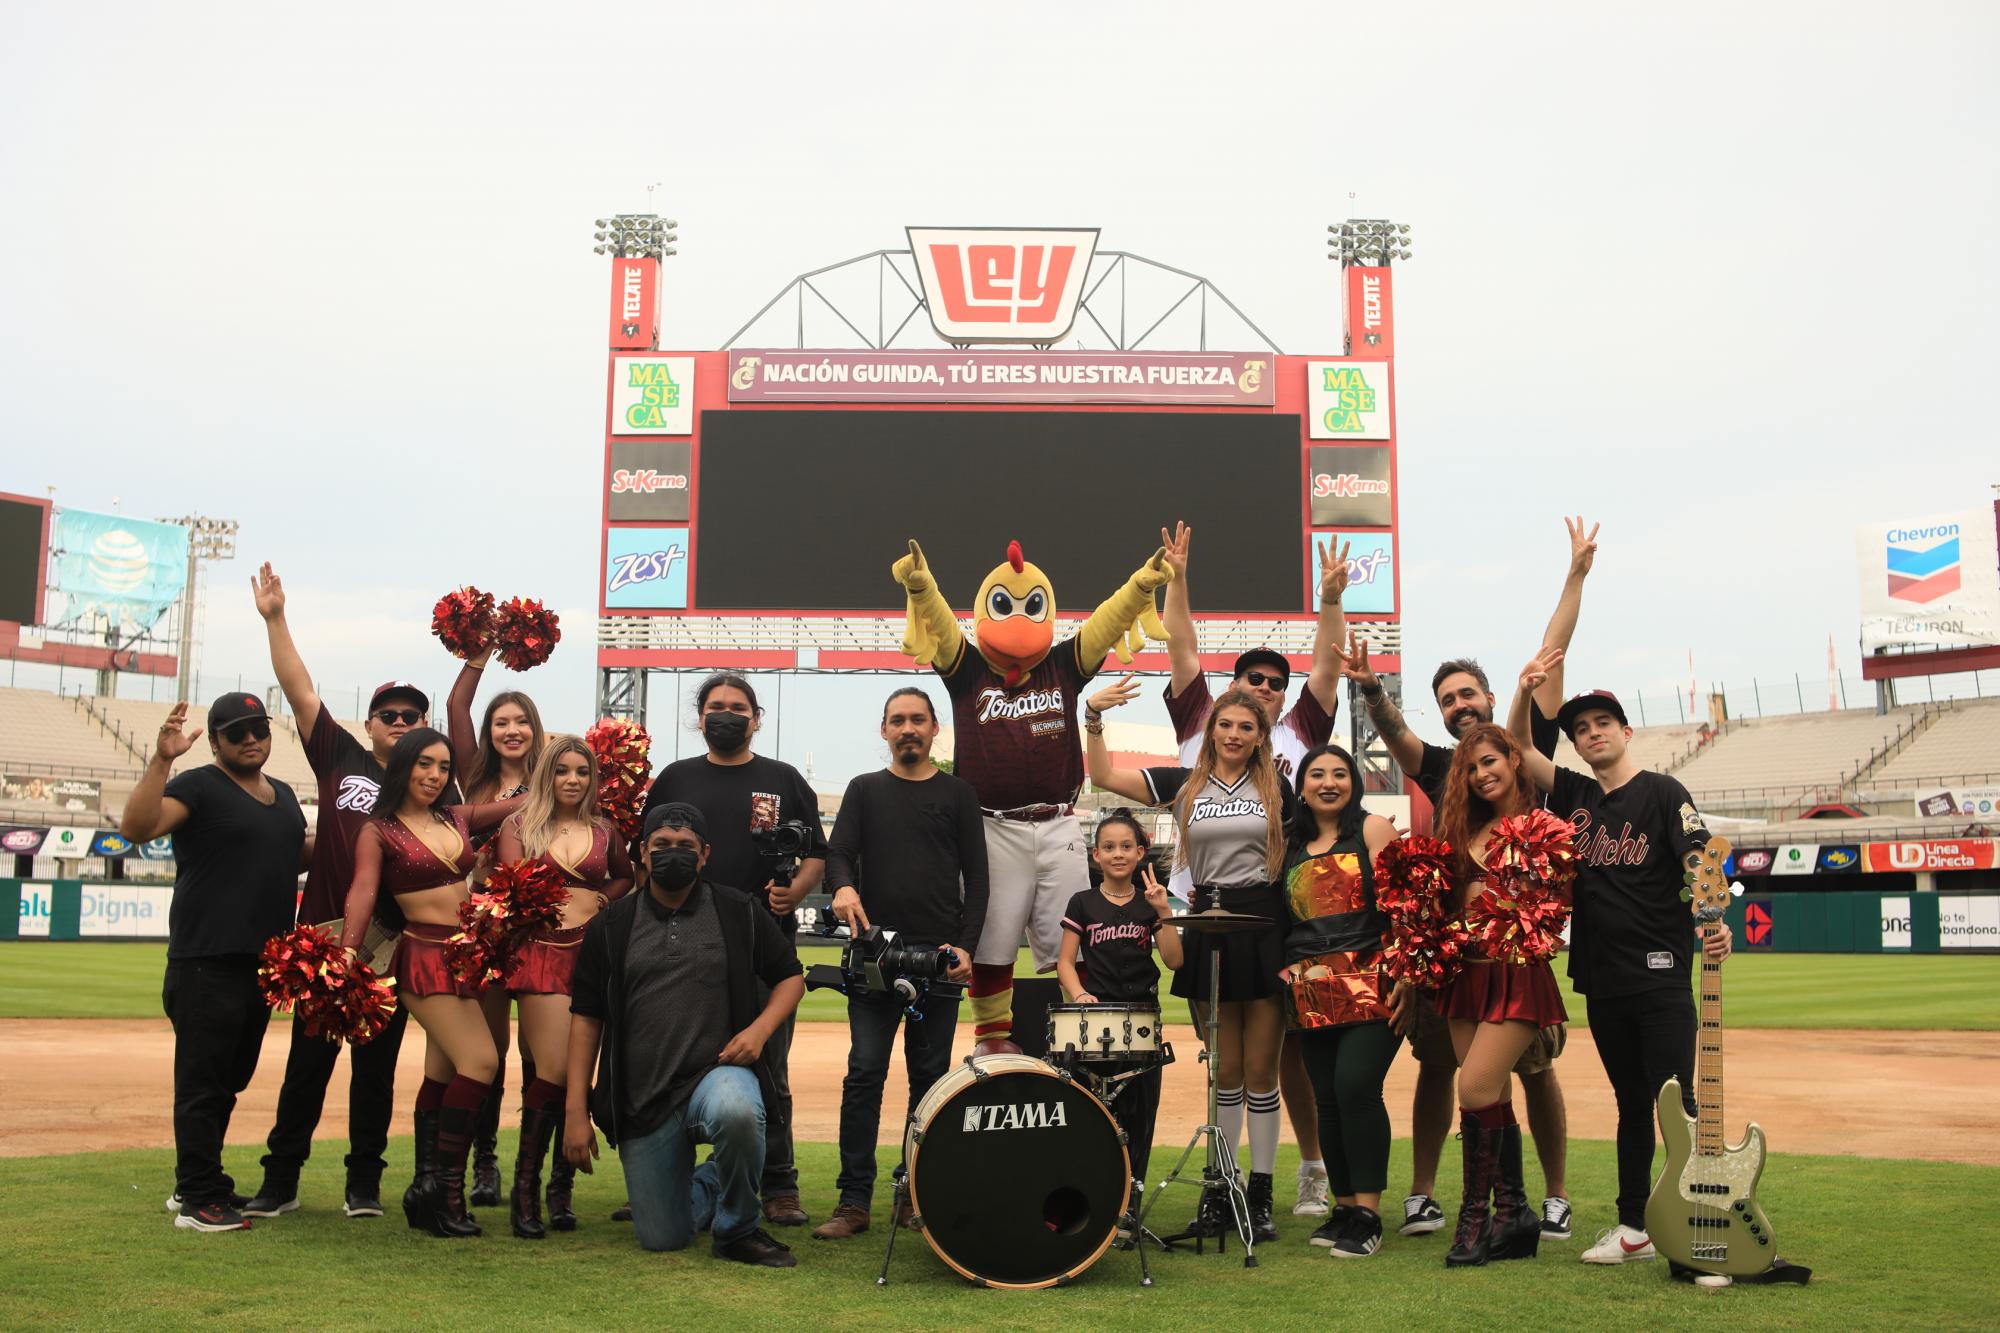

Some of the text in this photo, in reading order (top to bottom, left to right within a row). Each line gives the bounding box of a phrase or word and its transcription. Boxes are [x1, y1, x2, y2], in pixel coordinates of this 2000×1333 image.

[623, 265, 642, 321] TECATE
[929, 244, 1076, 323] Ley
[1363, 273, 1381, 330] TECATE
[763, 359, 1236, 386] NACIÓN GUINDA, TÚ ERES NUESTRA FUERZA
[611, 469, 687, 493] SuKarne
[1314, 473, 1388, 497] SuKarne
[1886, 523, 1960, 543] Chevron
[1188, 797, 1268, 827] Tomatero
[1569, 808, 1649, 867] Culichi
[1927, 854, 1975, 867] Directa
[82, 894, 153, 923] Digna
[795, 907, 817, 924] 18
[1086, 921, 1151, 947] Tomater
[984, 1102, 1068, 1131] TAMA
